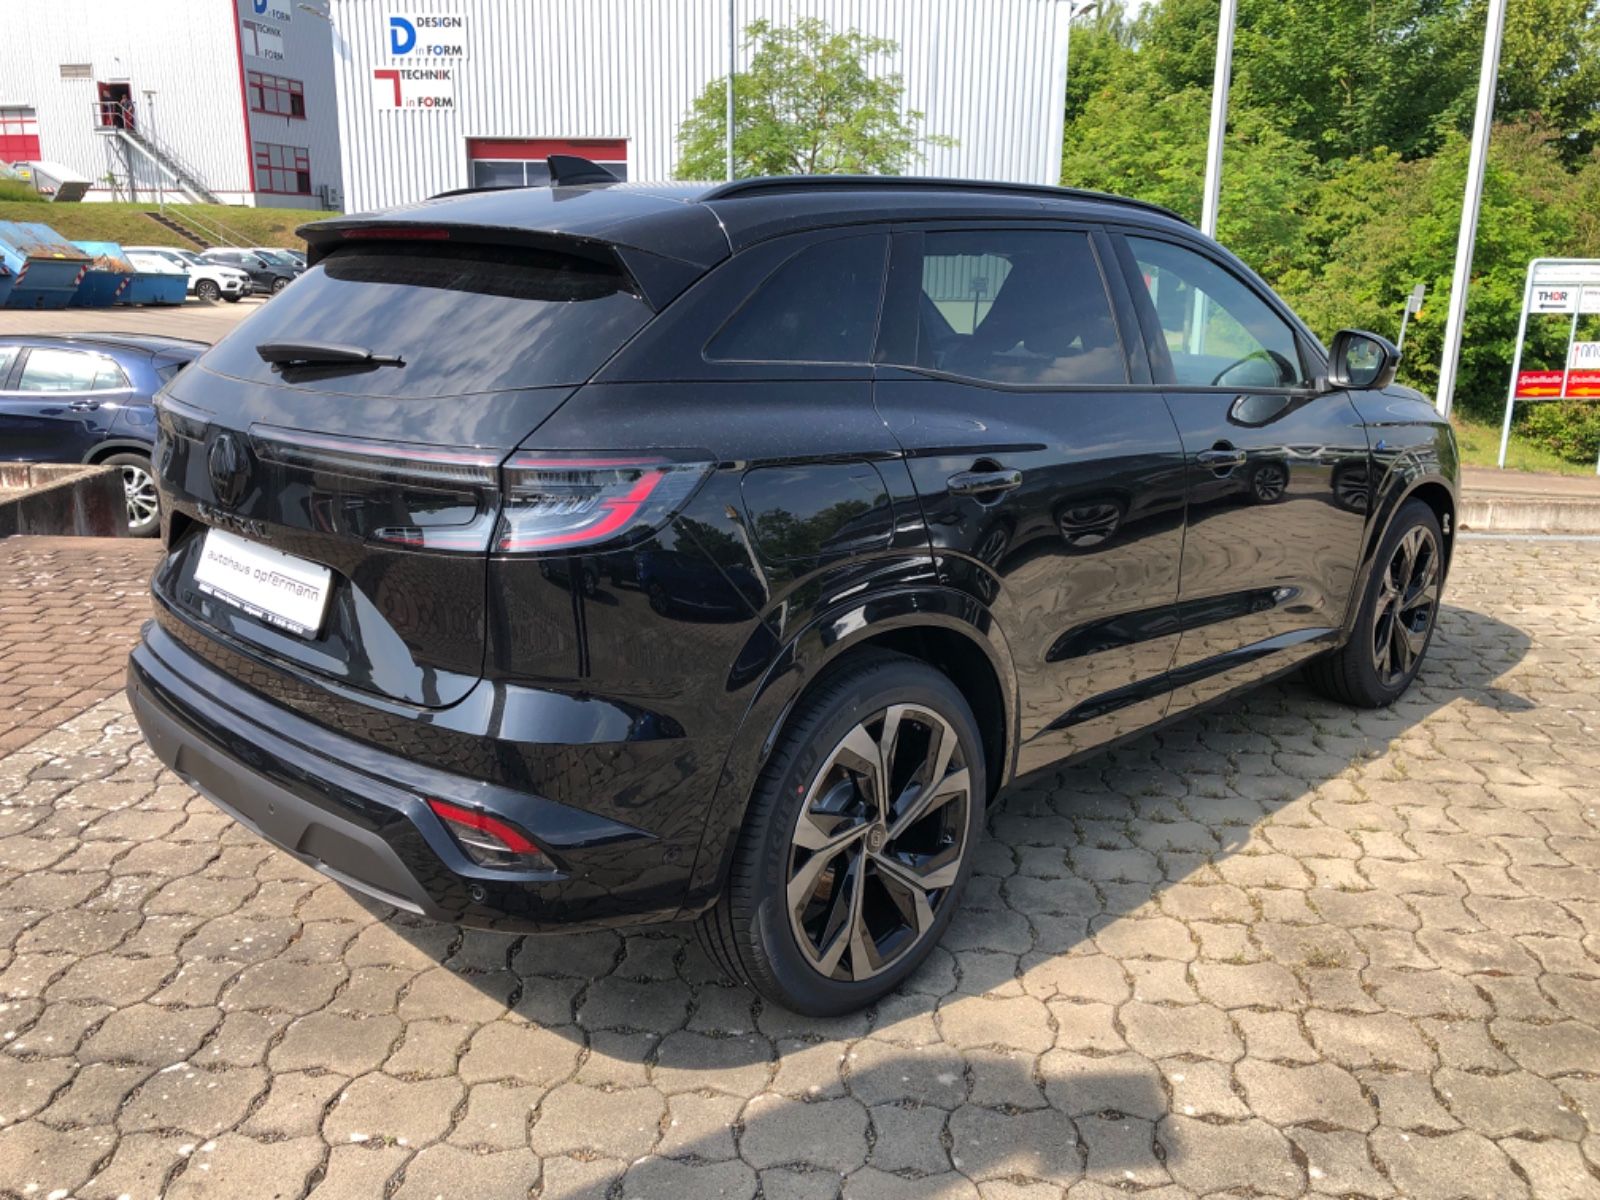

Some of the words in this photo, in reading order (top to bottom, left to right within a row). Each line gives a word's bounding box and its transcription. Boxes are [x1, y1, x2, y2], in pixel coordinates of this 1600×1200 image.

[416, 17, 462, 28] DESIGN
[389, 16, 417, 55] D
[416, 45, 424, 56] in
[427, 45, 463, 56] FORM
[400, 69, 451, 80] TECHNIK
[406, 96, 415, 107] in
[417, 97, 453, 107] FORM
[1538, 291, 1568, 301] THOR
[206, 549, 251, 576] autohaus
[253, 567, 320, 602] opfermann
